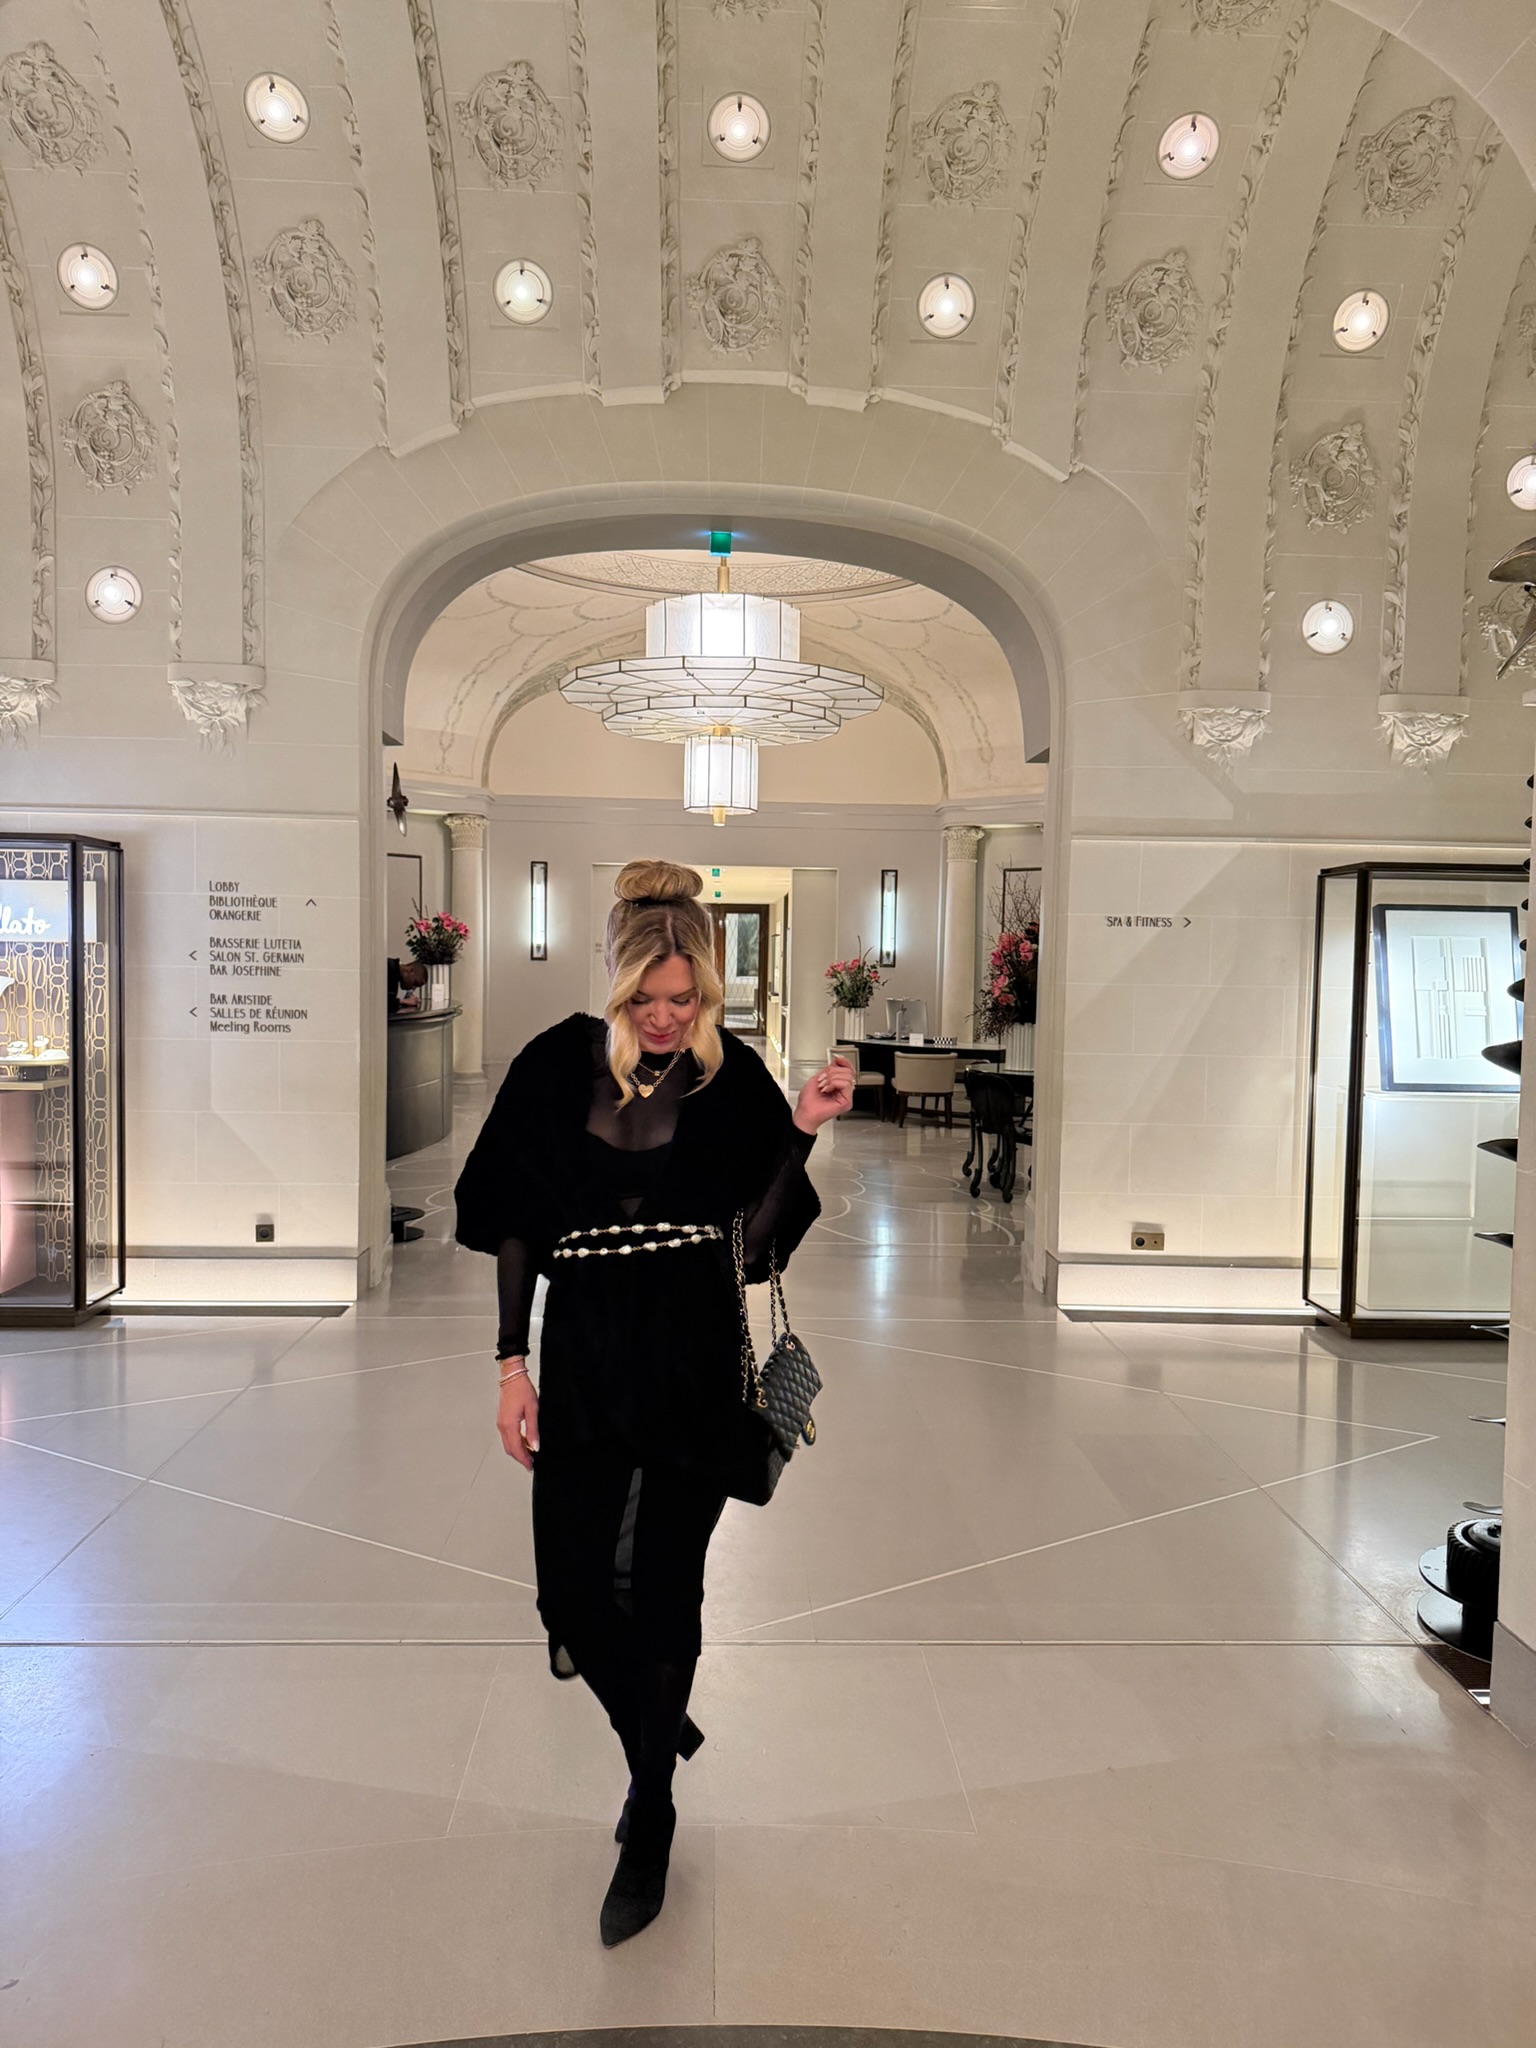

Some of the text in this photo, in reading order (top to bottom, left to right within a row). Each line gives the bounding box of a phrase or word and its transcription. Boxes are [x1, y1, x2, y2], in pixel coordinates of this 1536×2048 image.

[209, 880, 240, 892] LOBBY
[209, 895, 278, 908] BIBLIOTHÈQUE
[209, 909, 262, 921] ORANGERIE
[1106, 916, 1173, 928] SPA & FITNESS
[209, 937, 302, 950] BRASSERIE LUTETIA
[209, 950, 304, 963] SALON ST. GERMAIN
[209, 964, 228, 976] BAR
[209, 993, 273, 1005] BAR ARISTIDE
[209, 1006, 308, 1020] SALLES DE RÉUNION
[209, 1021, 291, 1034] Meeting Rooms
